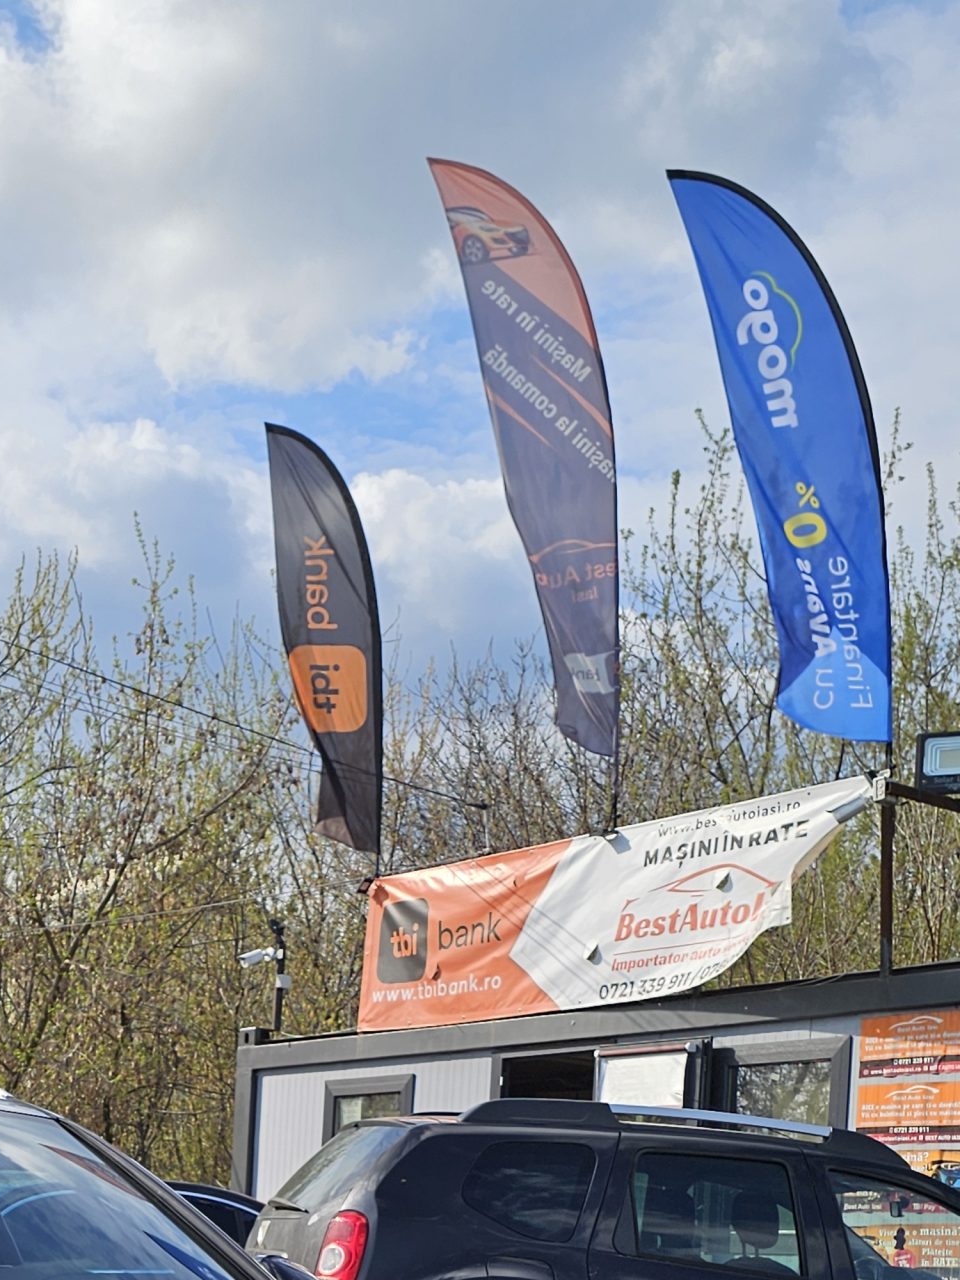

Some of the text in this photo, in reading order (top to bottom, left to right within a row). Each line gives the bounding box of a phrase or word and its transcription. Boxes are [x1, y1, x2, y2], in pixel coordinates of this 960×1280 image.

[657, 801, 801, 838] www.besutoiasi.ro
[748, 819, 810, 848] RATE
[390, 912, 502, 959] tbi bank
[611, 953, 690, 973] Importator
[372, 974, 502, 1003] www.tbibank.ro
[599, 980, 635, 1000] 0721
[639, 976, 666, 996] 339
